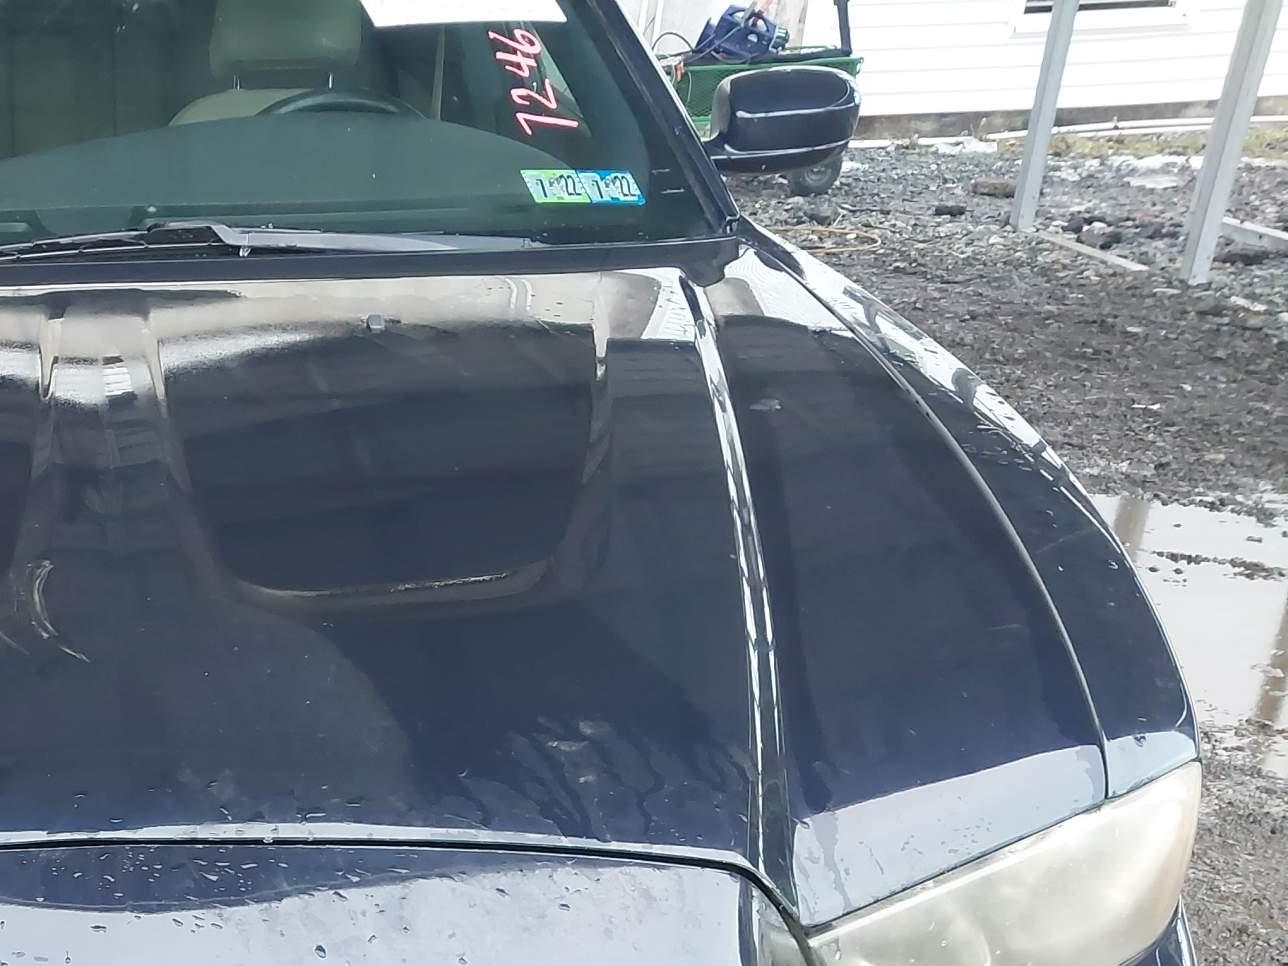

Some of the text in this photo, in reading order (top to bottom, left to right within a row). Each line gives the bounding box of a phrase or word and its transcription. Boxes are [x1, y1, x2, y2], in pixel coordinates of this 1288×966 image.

[488, 28, 579, 137] 7246
[559, 174, 582, 196] 22
[613, 175, 637, 197] 22
